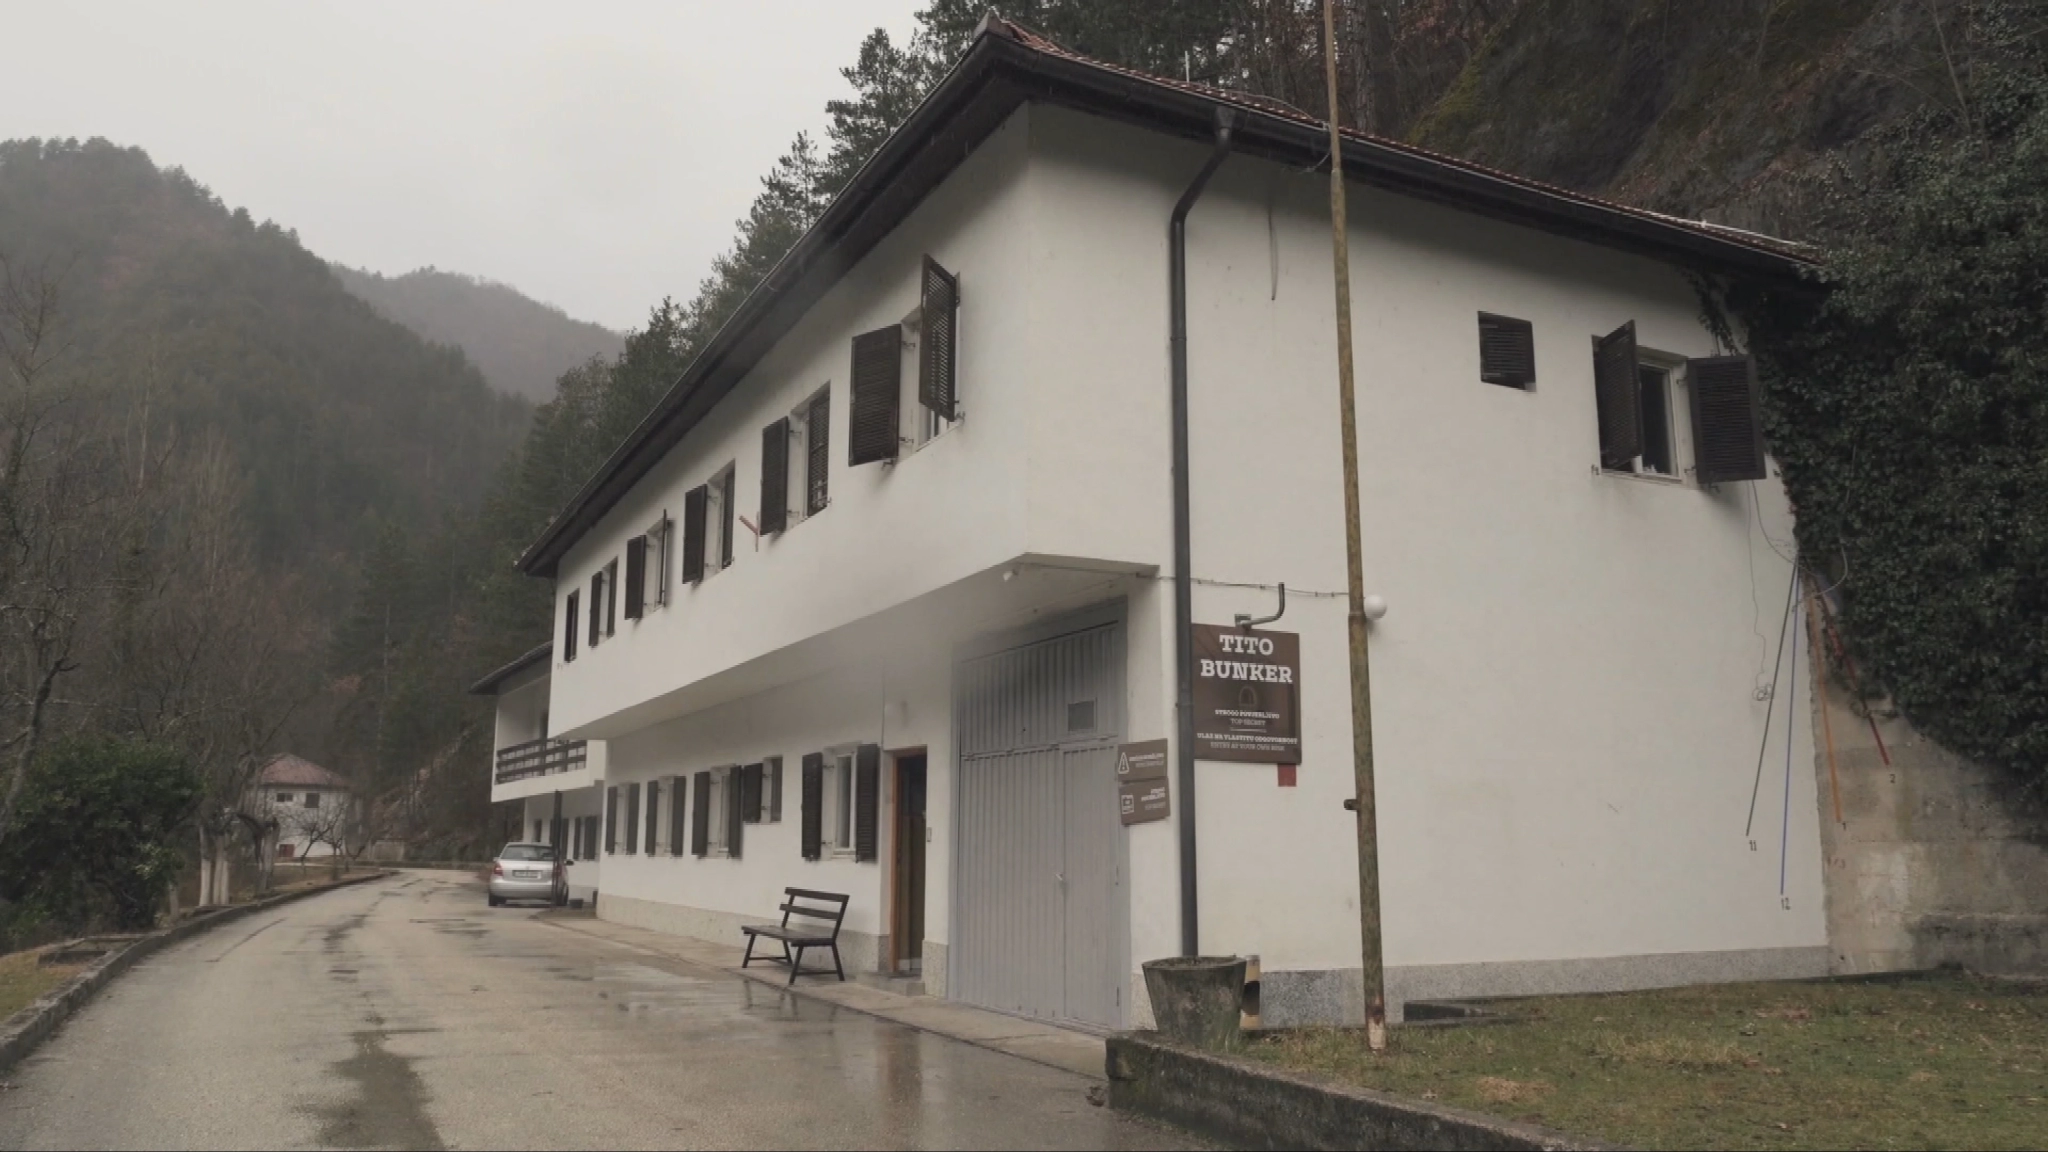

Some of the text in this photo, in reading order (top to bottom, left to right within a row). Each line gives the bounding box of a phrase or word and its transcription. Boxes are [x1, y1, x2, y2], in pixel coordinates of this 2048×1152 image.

[1219, 634, 1274, 656] TITO
[1200, 659, 1293, 684] BUNKER
[1889, 773, 1896, 784] 2
[1781, 897, 1791, 911] 12
